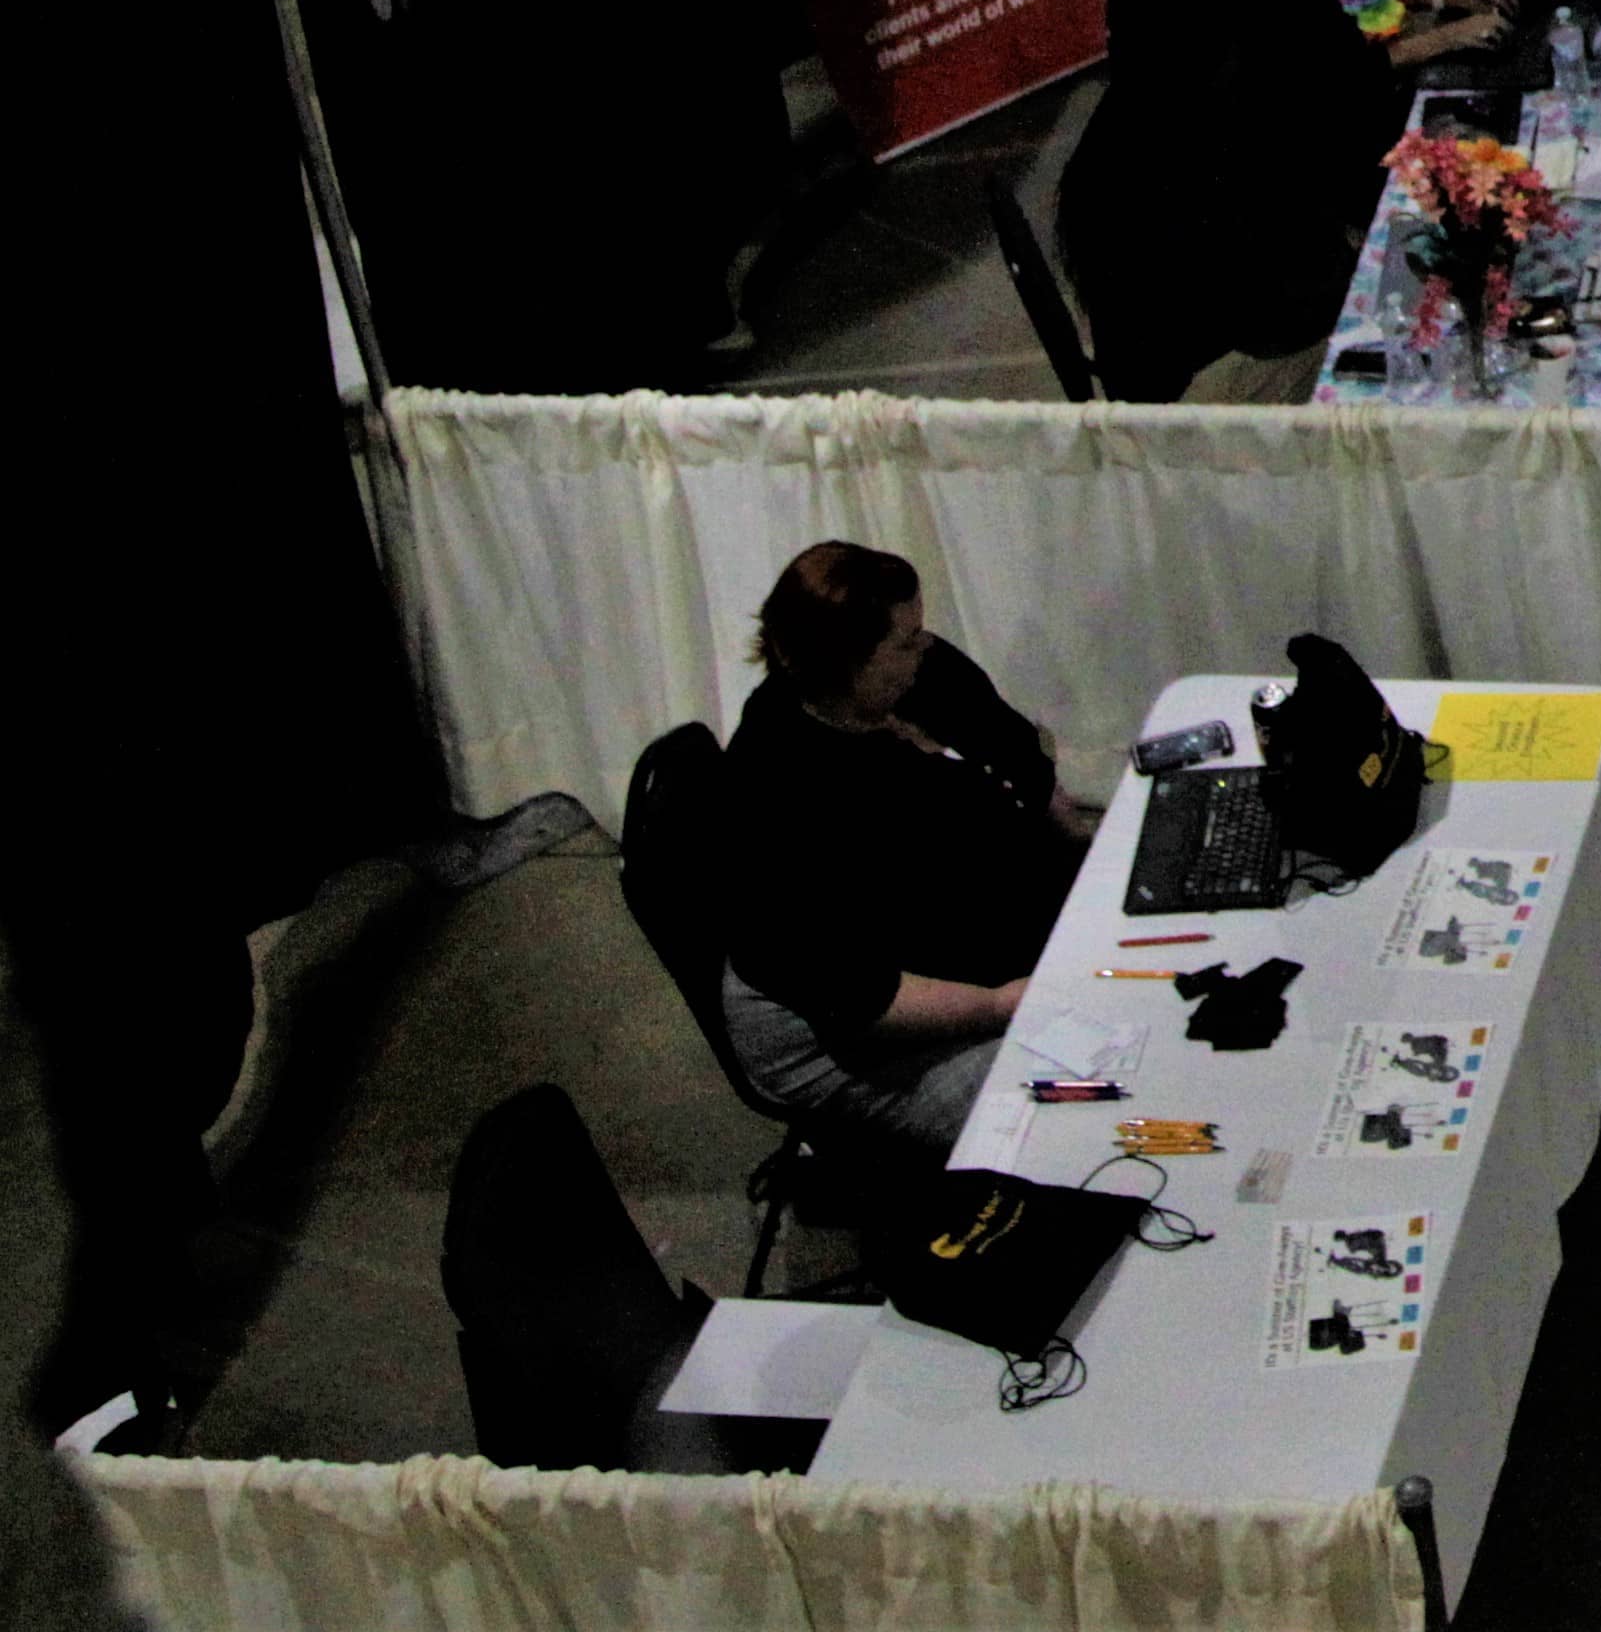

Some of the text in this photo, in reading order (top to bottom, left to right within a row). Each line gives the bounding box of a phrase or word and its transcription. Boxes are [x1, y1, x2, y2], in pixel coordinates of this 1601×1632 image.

[864, 5, 930, 46] clients
[877, 38, 922, 70] their
[926, 6, 981, 47] world
